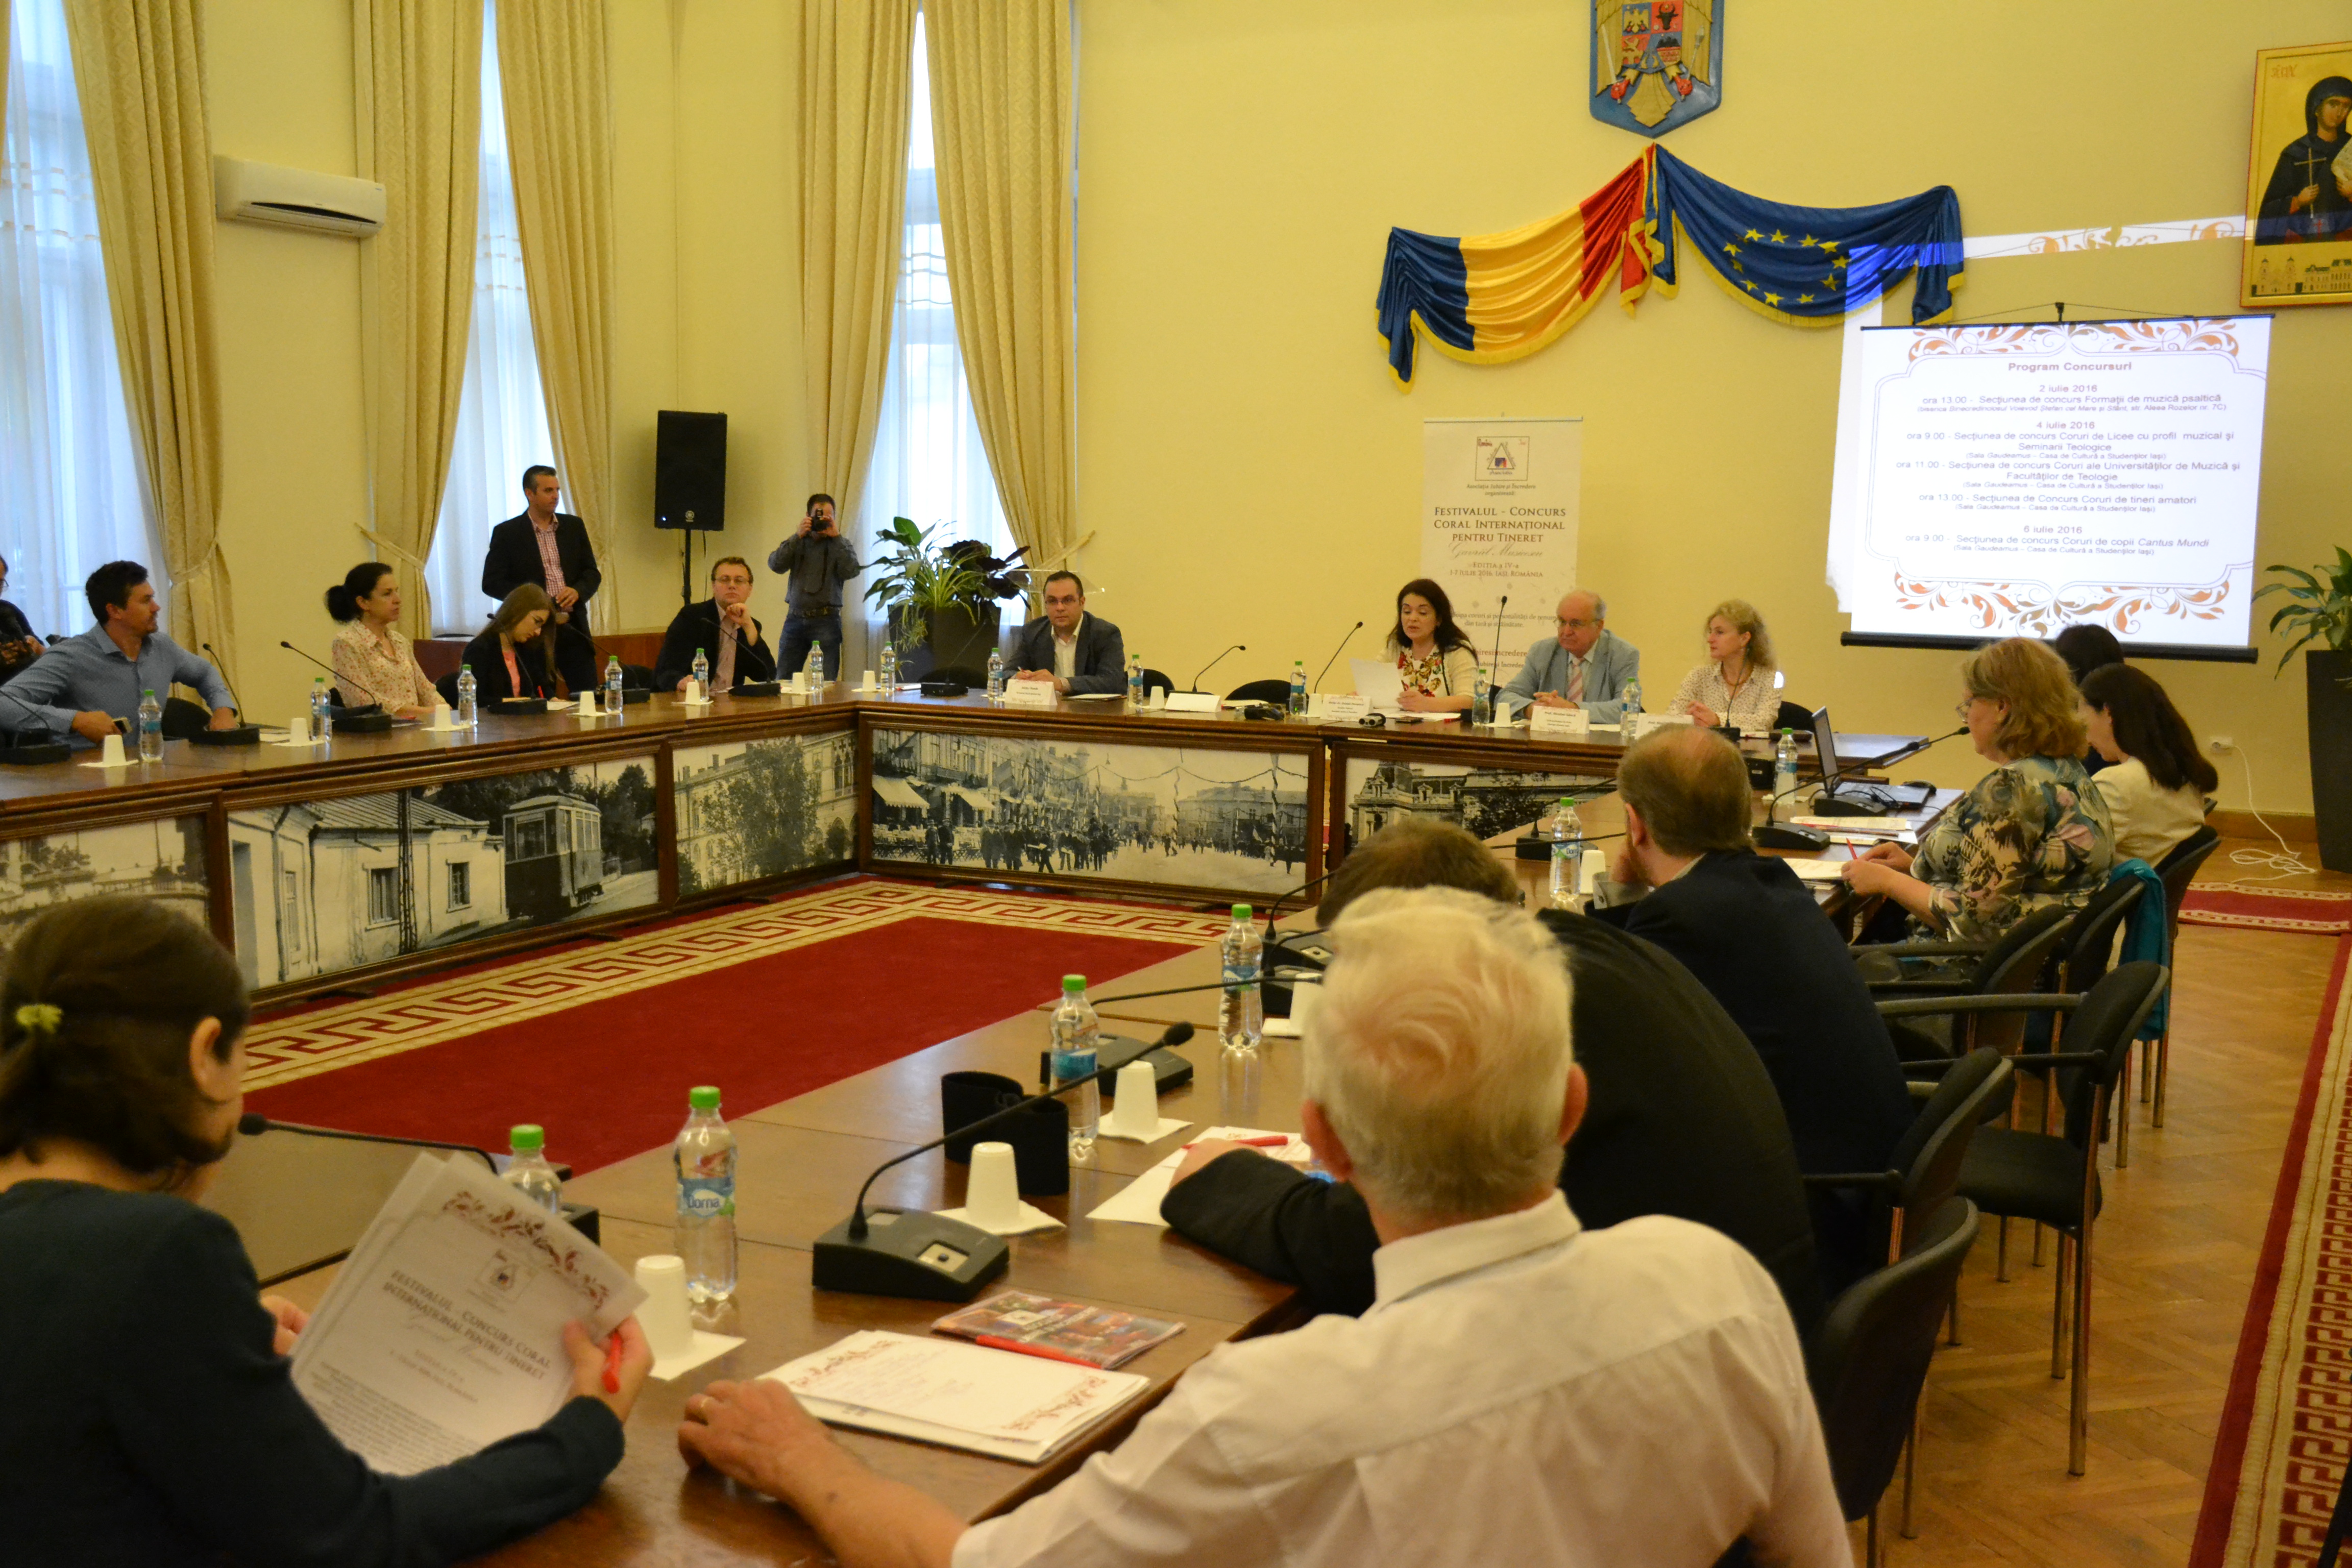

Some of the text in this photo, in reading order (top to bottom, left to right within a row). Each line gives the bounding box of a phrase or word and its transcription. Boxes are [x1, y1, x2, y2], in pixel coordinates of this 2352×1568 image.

[2008, 362, 2132, 373] Program Concursuri
[2152, 432, 2177, 441] profil
[2067, 444, 2112, 452] Teologice
[2077, 473, 2119, 482] Teologie
[1435, 507, 1566, 516] FESTIVALUL CONCURS
[1434, 520, 1471, 528] CORAL
[1453, 533, 1544, 542] PENTRU TINERET
[2138, 538, 2175, 547] Cantus
